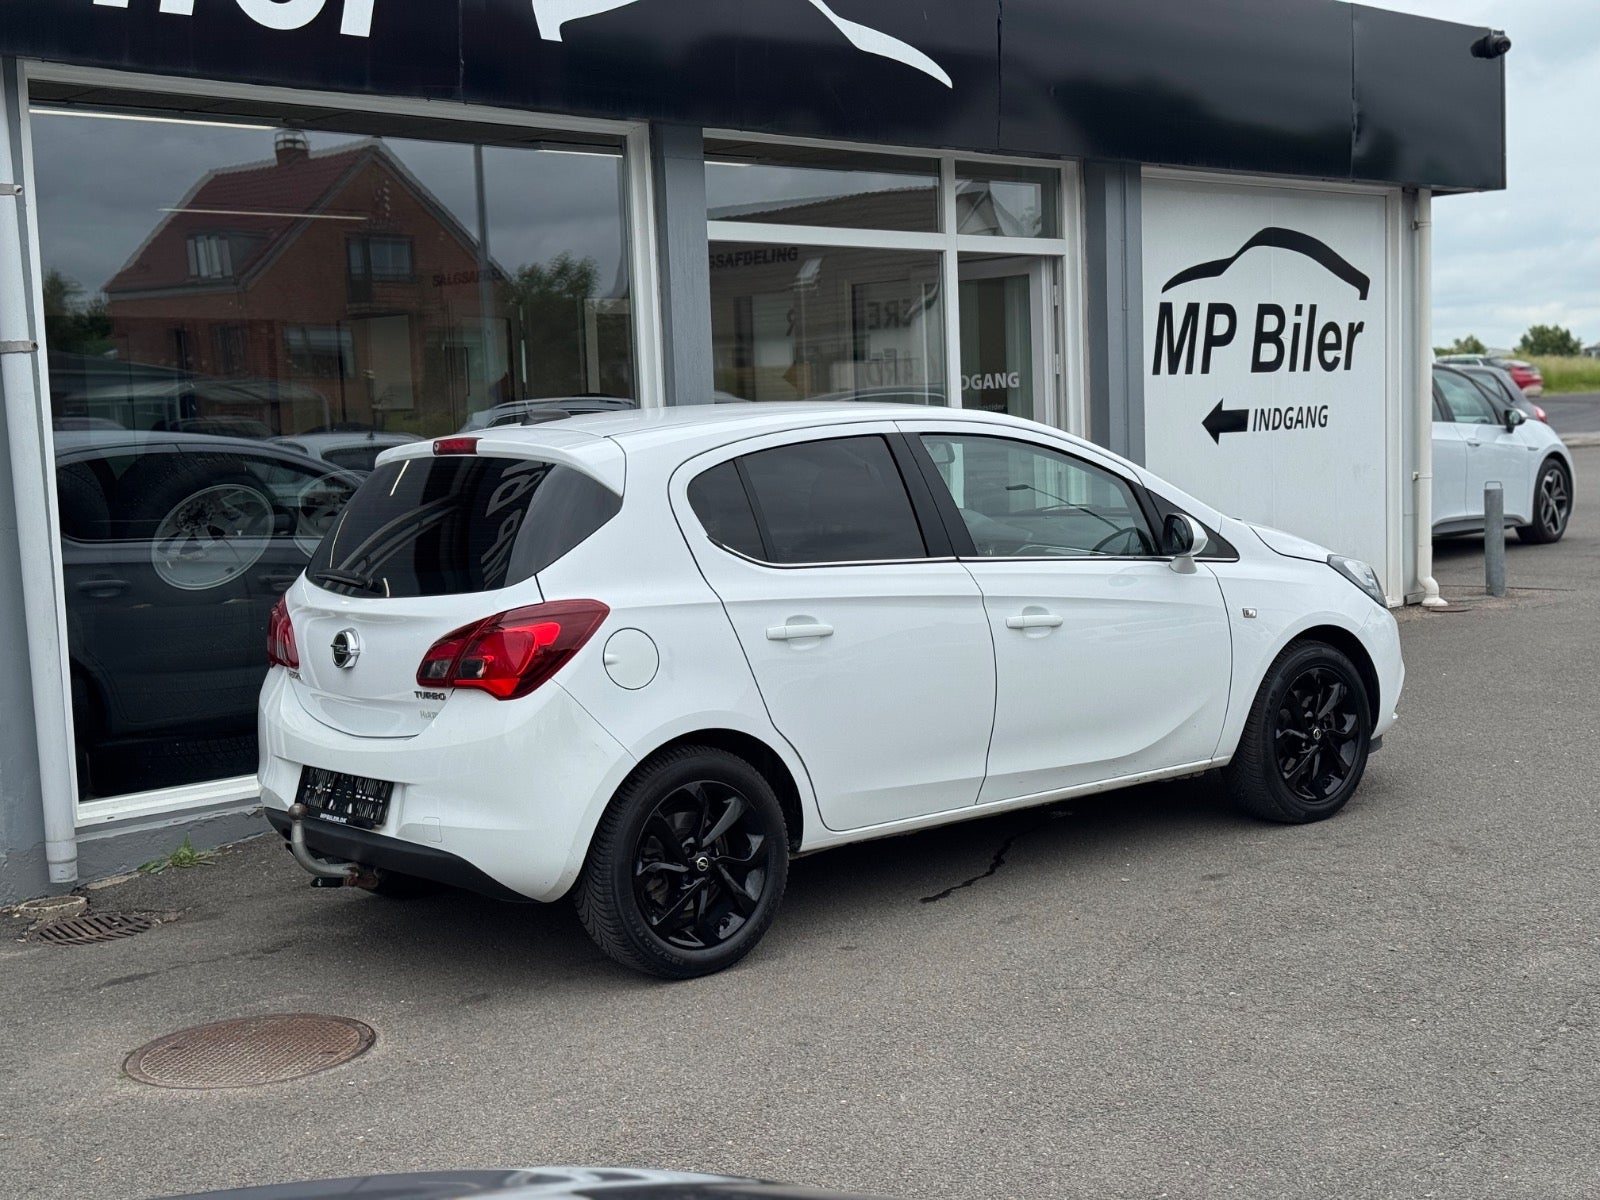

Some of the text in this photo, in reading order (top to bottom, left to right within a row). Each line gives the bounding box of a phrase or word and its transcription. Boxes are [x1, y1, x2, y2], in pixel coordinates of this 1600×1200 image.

[1152, 301, 1365, 375] MP Biler
[1252, 405, 1329, 432] INDGANG
[413, 690, 447, 701] TURBO
